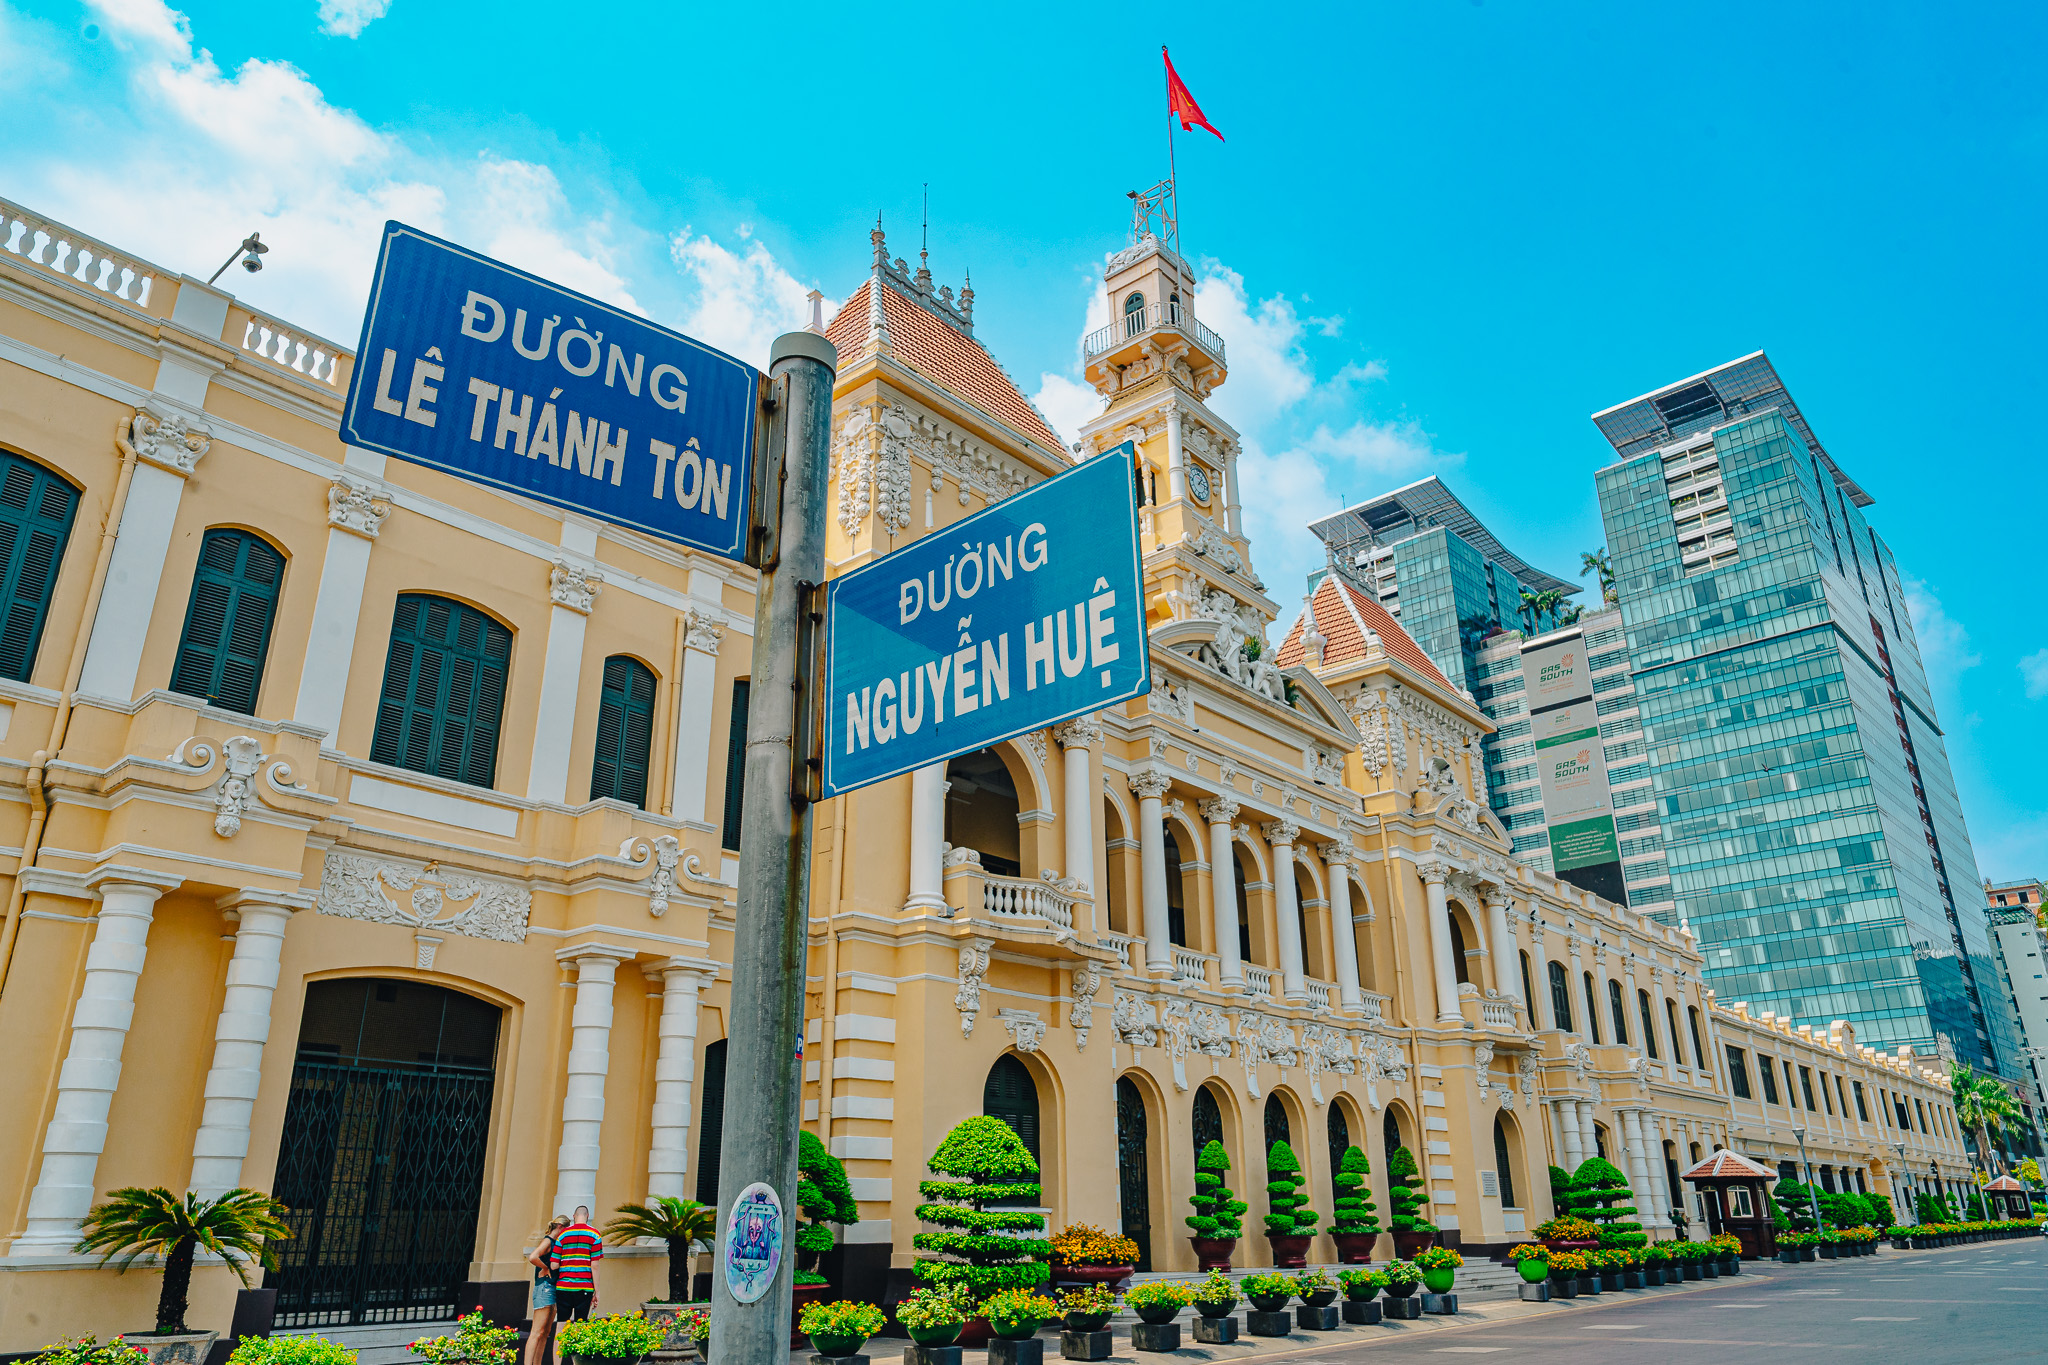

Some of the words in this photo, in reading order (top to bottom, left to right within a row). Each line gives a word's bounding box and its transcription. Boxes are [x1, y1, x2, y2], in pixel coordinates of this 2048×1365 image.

[460, 289, 688, 414] ĐƯỜNG
[373, 345, 446, 428] LÊ
[467, 376, 629, 487] THÁNH
[649, 436, 732, 521] TÔN
[898, 522, 1048, 626] ĐƯỜNG
[846, 614, 1010, 755] NGUYỄN
[1024, 576, 1120, 692] HUỆ
[1540, 663, 1560, 674] GAS
[1540, 668, 1573, 682] SOUTH
[1554, 765, 1589, 778] SOUTH
[1555, 759, 1576, 770] GAS
